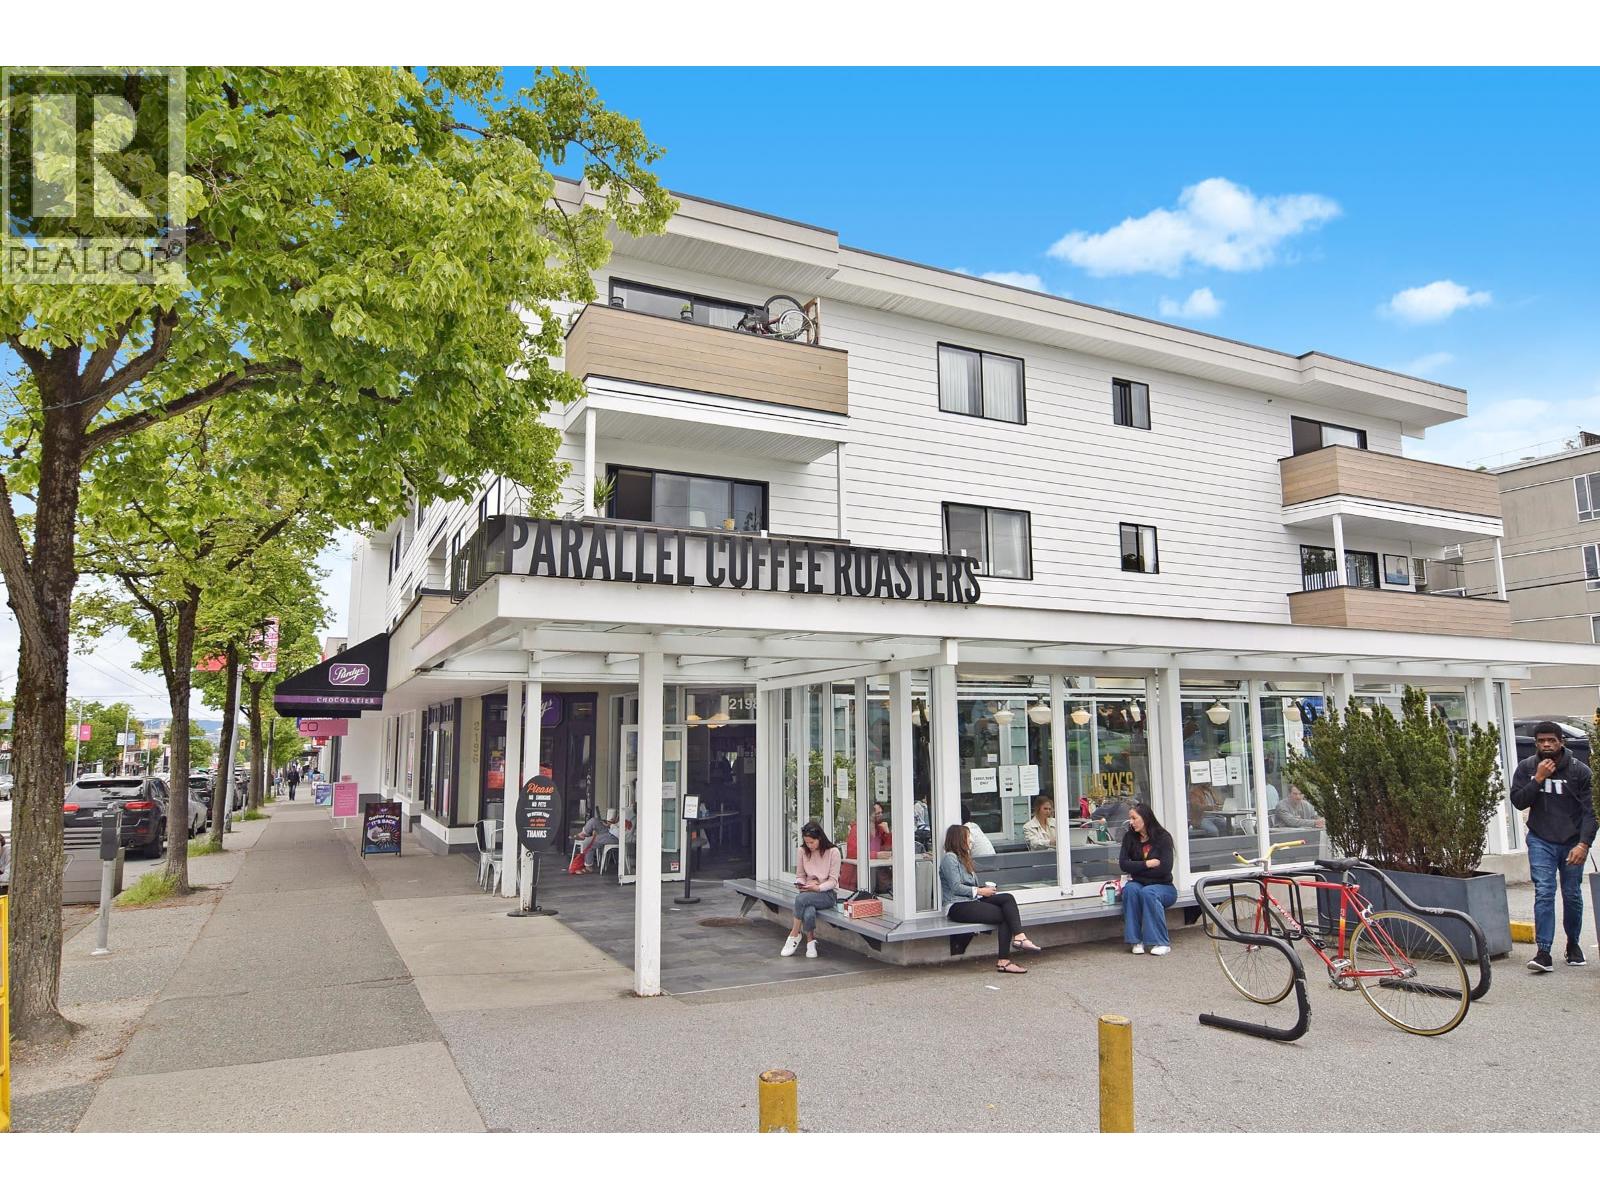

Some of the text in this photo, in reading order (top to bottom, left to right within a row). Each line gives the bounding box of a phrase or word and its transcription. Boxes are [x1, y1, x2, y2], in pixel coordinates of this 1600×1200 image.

[504, 516, 981, 604] PARALLEL COFFEE ROASTERS
[333, 667, 365, 683] Purdys
[527, 783, 554, 794] Please
[527, 830, 547, 838] THANKS
